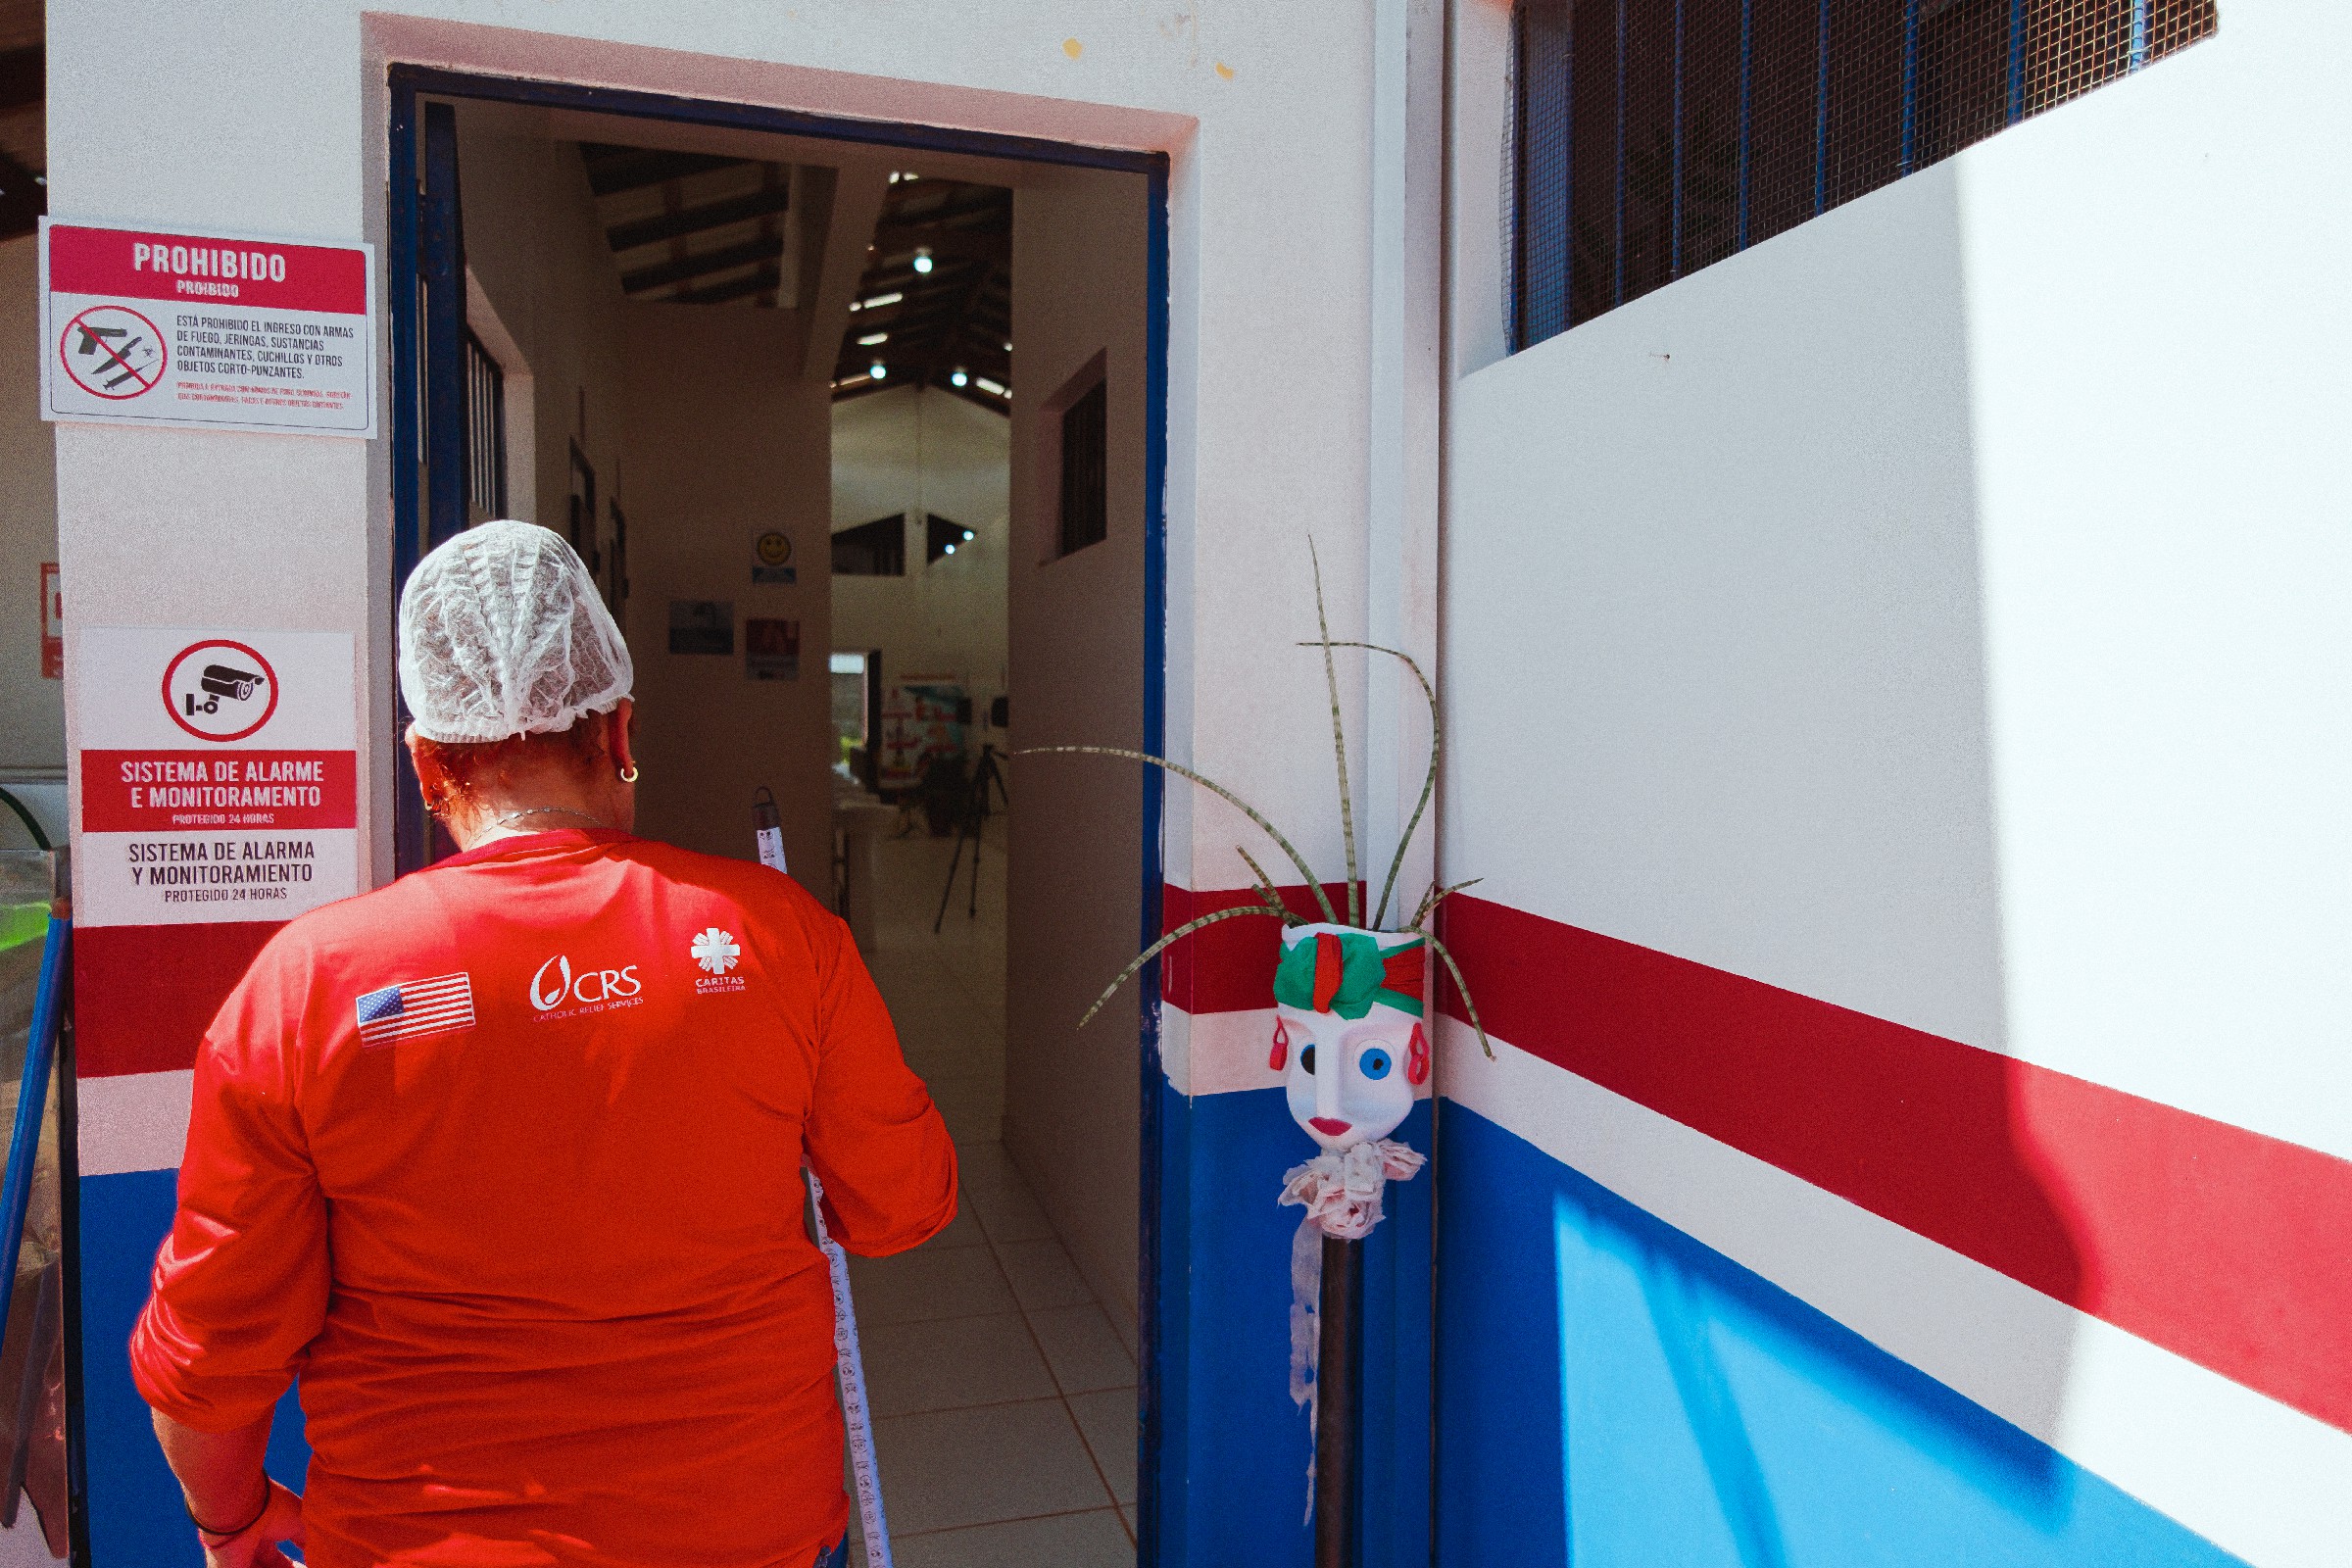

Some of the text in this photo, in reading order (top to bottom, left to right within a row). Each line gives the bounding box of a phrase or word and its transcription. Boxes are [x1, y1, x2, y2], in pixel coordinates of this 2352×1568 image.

[134, 242, 286, 283] PROHIBIDO
[176, 279, 239, 298] PROIBIDO
[176, 315, 354, 339] ESTÁ PROHIBIDO EL INGRESO CON ARMAS
[176, 330, 324, 351] DE FUEGO, JERINGAS, SUSTANCIAS
[176, 345, 343, 367] CONTAMINANTES, CUCHILLOS Y OTROS
[177, 360, 305, 379] OBJETOS CORTO-PUNZANTES.
[121, 760, 324, 783] SISTEMA DE ALARME
[130, 786, 320, 808] E MONITORAMENTO
[172, 812, 274, 824] PROTEGIDO 24 HORAS
[128, 841, 315, 862] SISTEMA DE ALARMA
[132, 863, 313, 885] Y MONITORAMIENTO
[165, 887, 287, 902] PROTEGIDO 24 HORAS
[573, 964, 641, 1003] CRS
